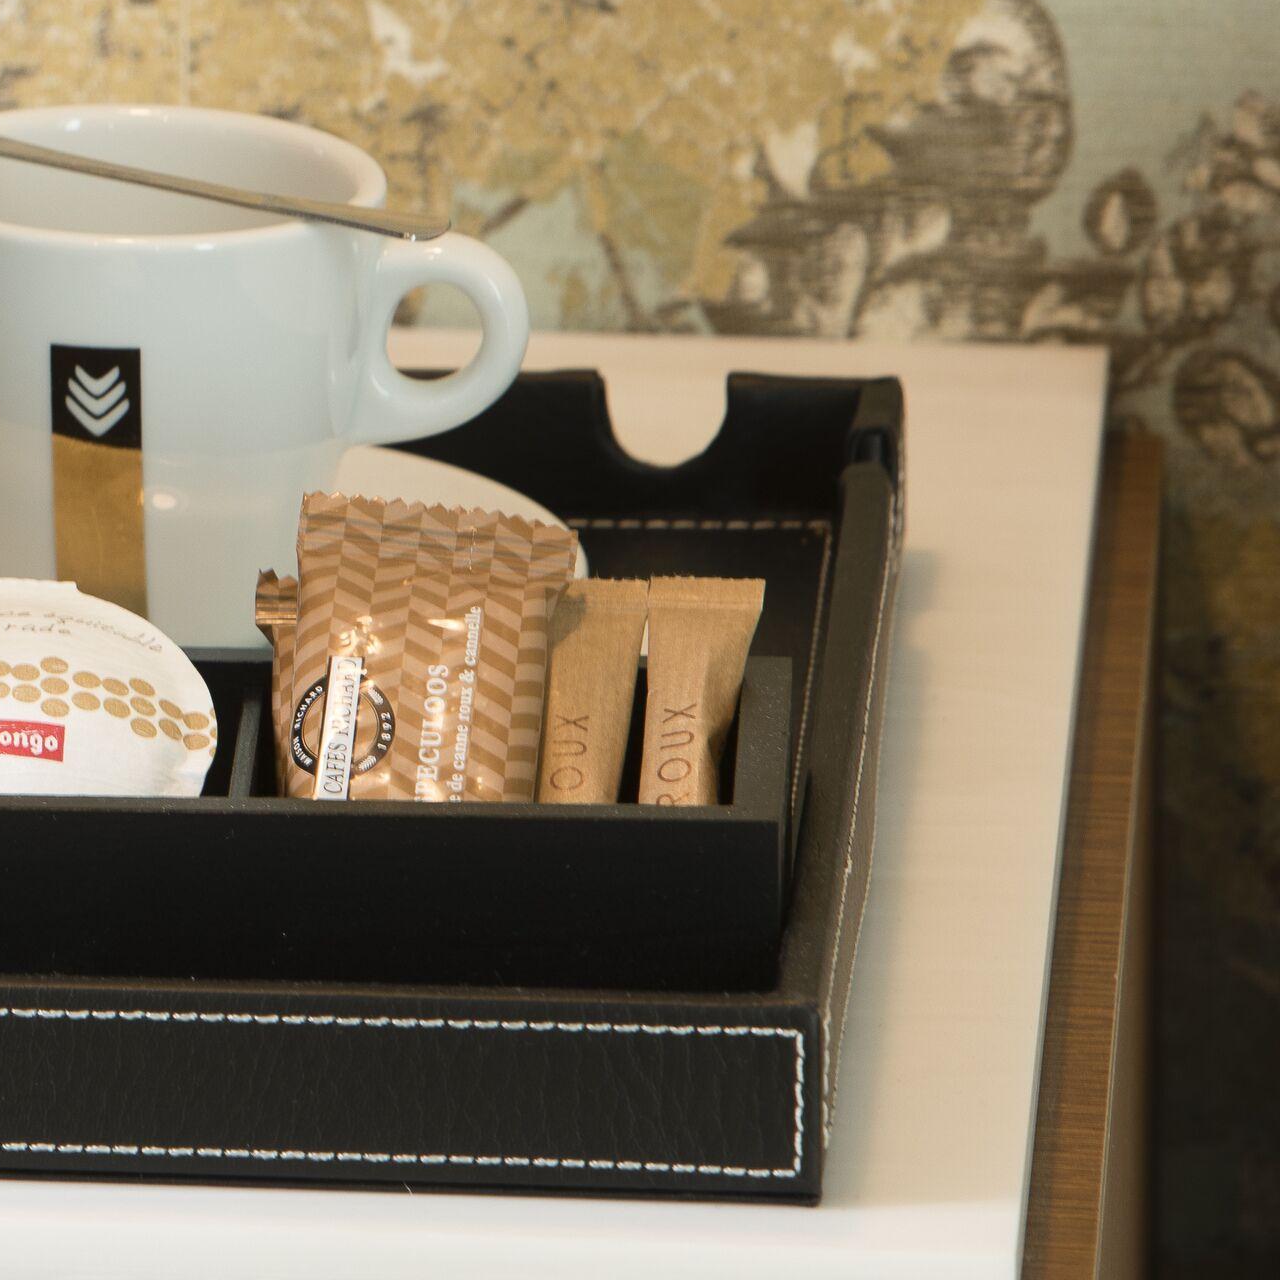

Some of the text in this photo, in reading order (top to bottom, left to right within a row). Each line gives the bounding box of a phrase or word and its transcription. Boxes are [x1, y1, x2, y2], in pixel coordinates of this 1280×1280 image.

[464, 606, 482, 666] cannelle
[458, 669, 475, 685] &
[458, 686, 473, 722] roux
[292, 684, 324, 767] MAISON RICHARD
[376, 711, 393, 751] 1892
[453, 724, 468, 770] canne
[446, 773, 464, 793] de
